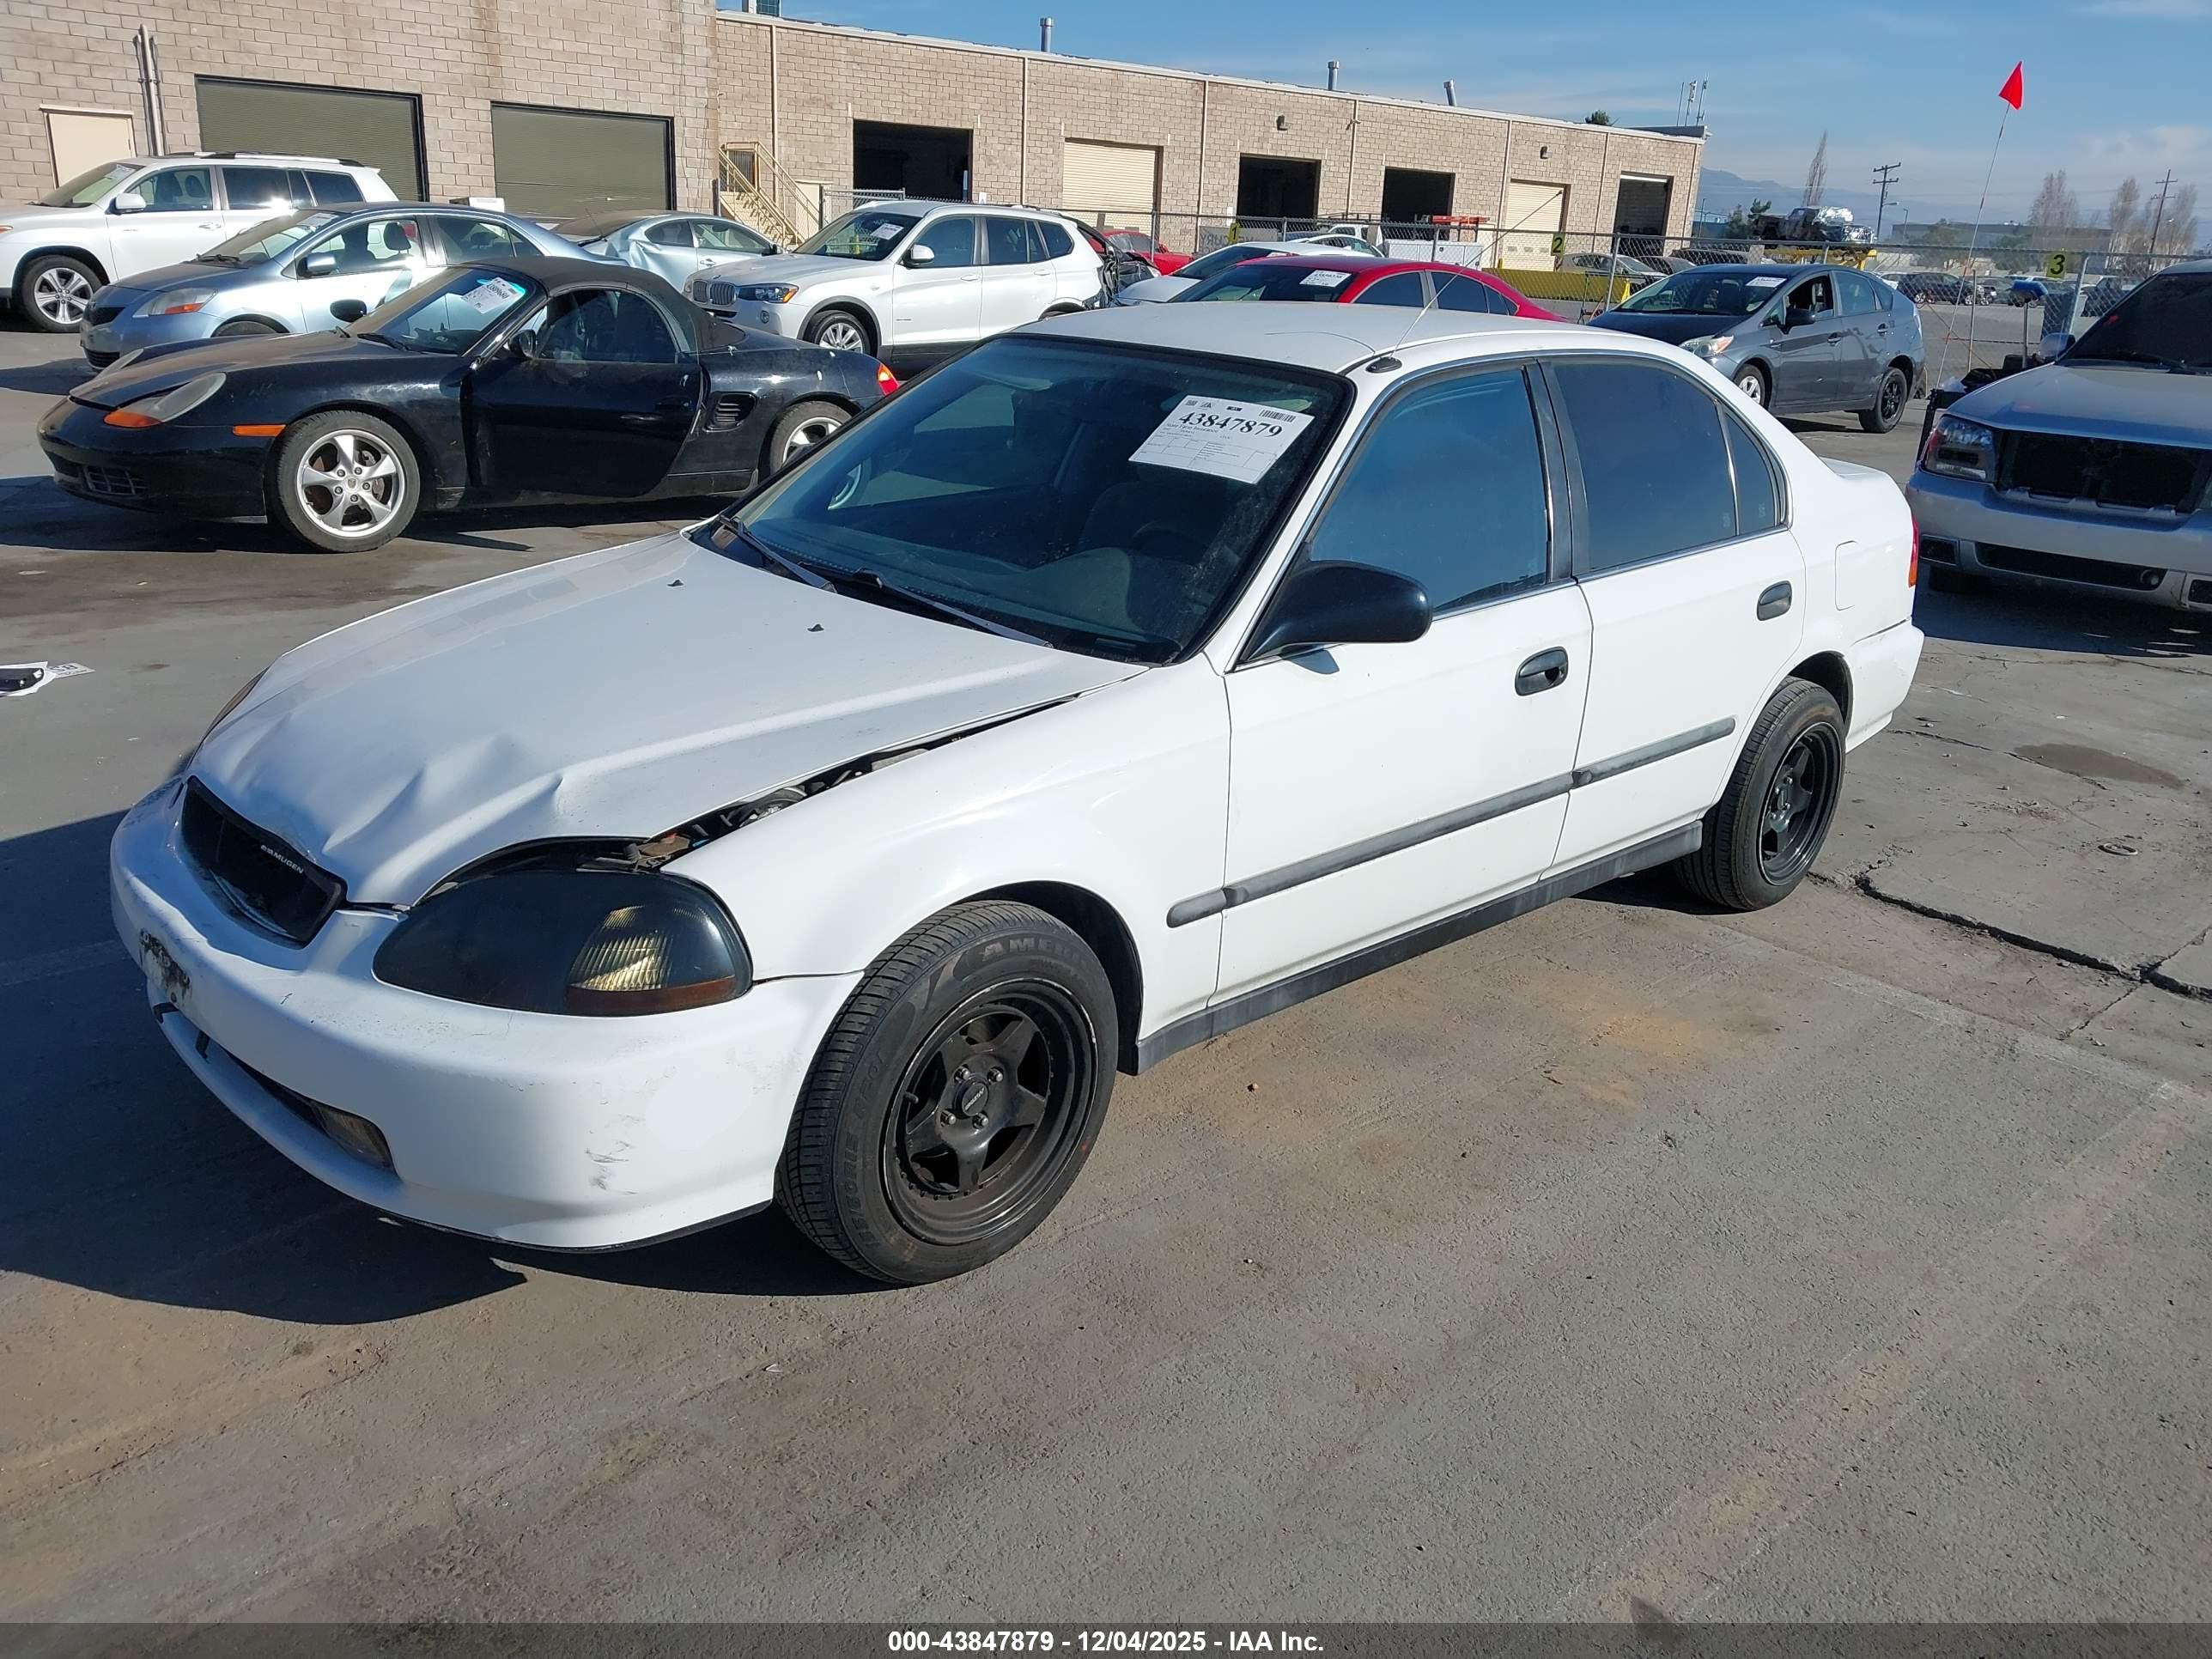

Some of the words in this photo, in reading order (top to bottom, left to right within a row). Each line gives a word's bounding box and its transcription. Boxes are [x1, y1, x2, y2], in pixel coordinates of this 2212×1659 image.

[1231, 225, 1237, 240] 1
[1552, 237, 1563, 253] 2
[2050, 253, 2066, 275] 3
[1178, 411, 1283, 438] 43847879
[273, 850, 305, 874] MUGEN
